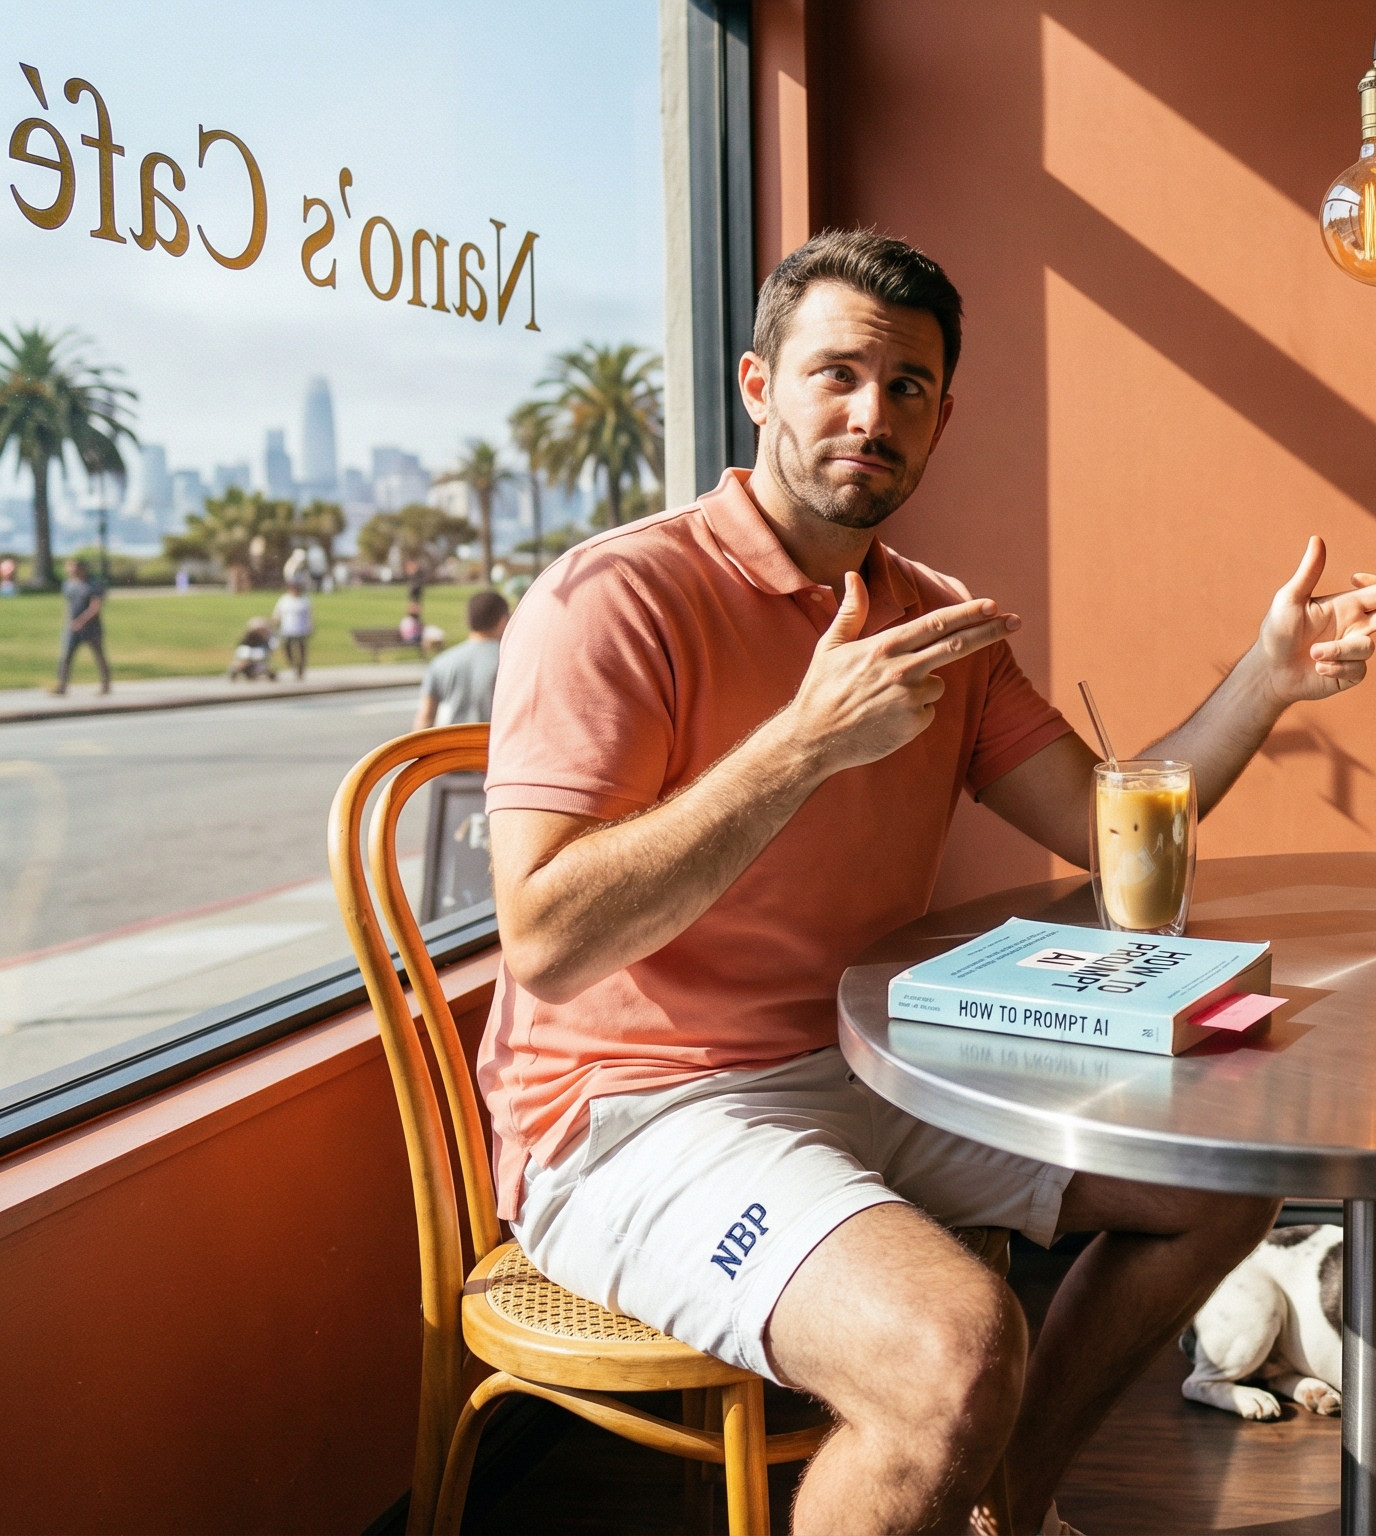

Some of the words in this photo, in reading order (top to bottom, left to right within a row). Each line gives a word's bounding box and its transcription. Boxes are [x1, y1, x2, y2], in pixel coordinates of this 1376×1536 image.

[1035, 951, 1086, 967] AI
[1125, 950, 1192, 978] HOW
[1097, 979, 1147, 994] TO
[959, 999, 994, 1021] HOW
[999, 1005, 1018, 1024] TO
[1023, 1008, 1088, 1034] PROMPT
[1093, 1018, 1109, 1037] AI
[710, 1203, 769, 1281] NBP
